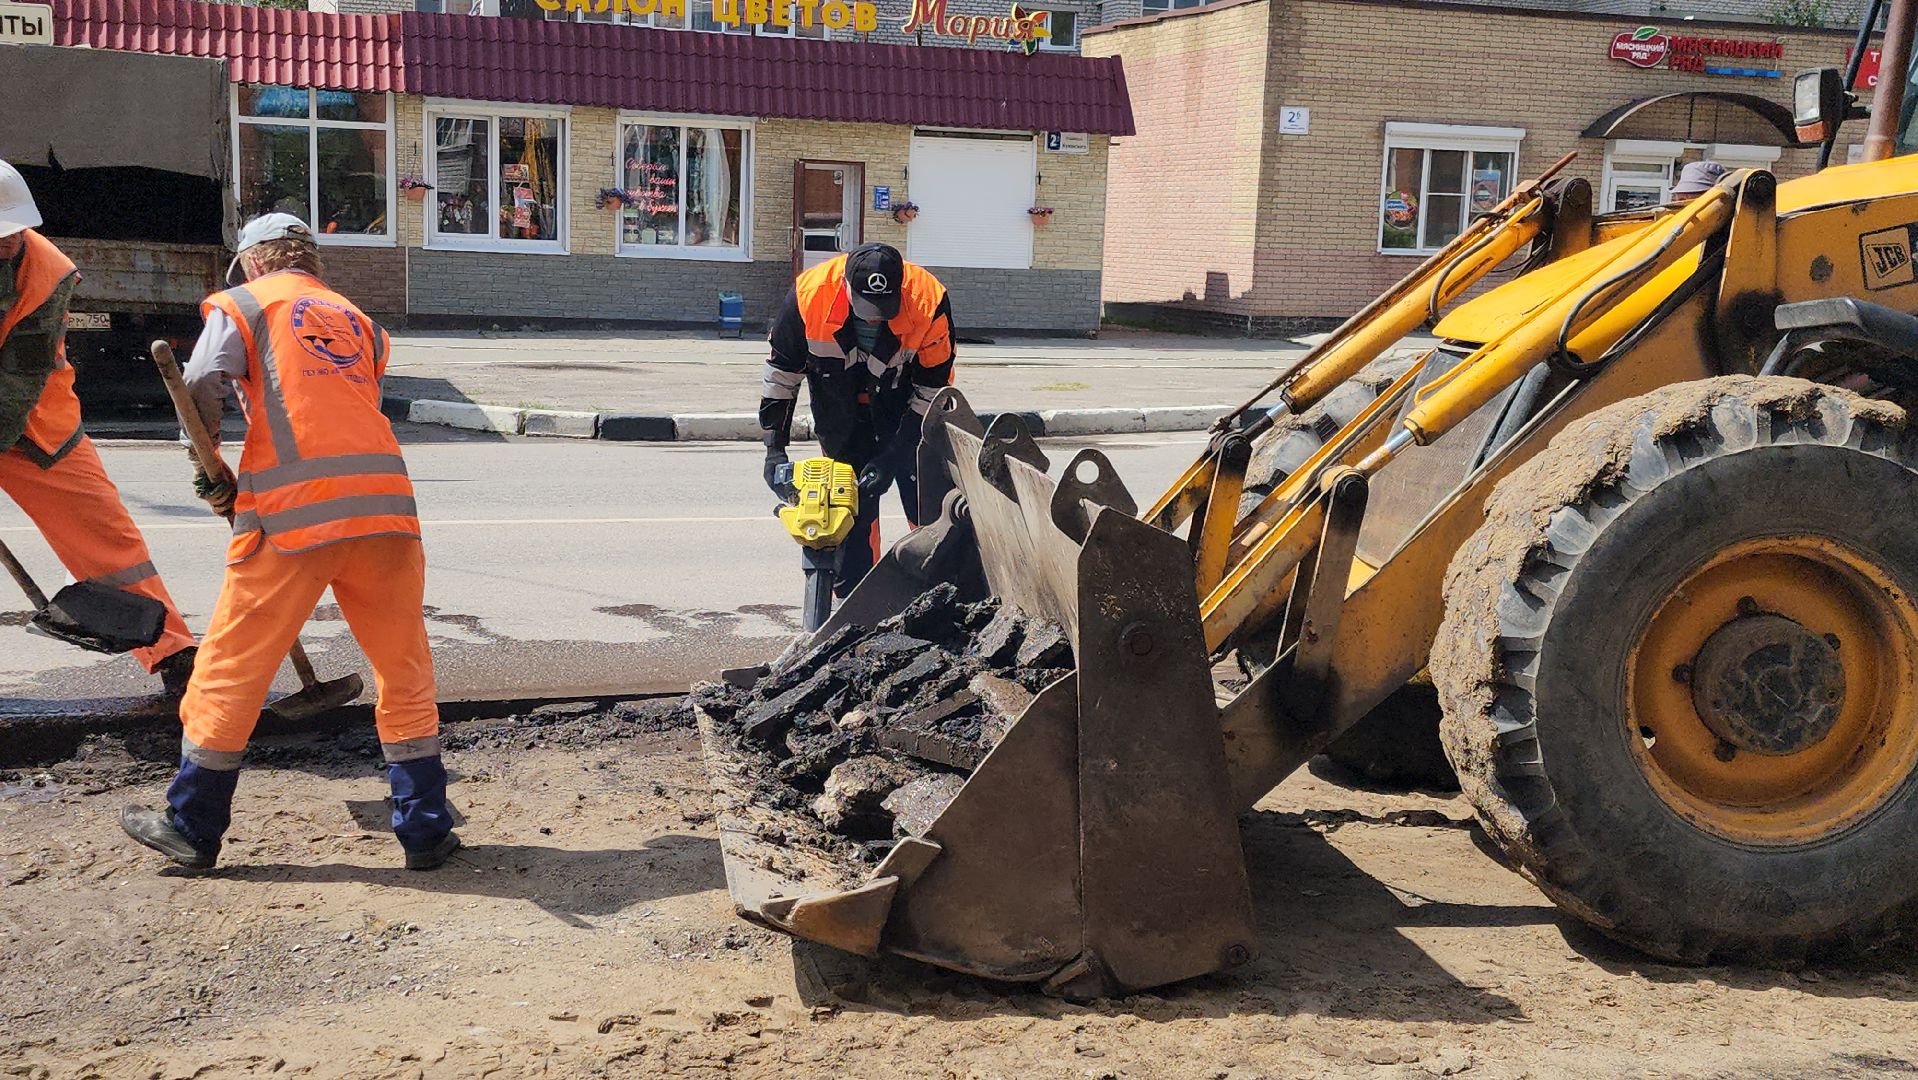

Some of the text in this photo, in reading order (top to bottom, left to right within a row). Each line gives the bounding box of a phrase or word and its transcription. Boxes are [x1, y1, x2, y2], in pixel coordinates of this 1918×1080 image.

[712, 0, 878, 32] ЦВЕТОВ
[902, 0, 1035, 45] Мария
[1615, 41, 1665, 52] МЯСНИЦКИЙ
[1632, 51, 1648, 60] РЯД
[1872, 246, 1906, 275] JCB
